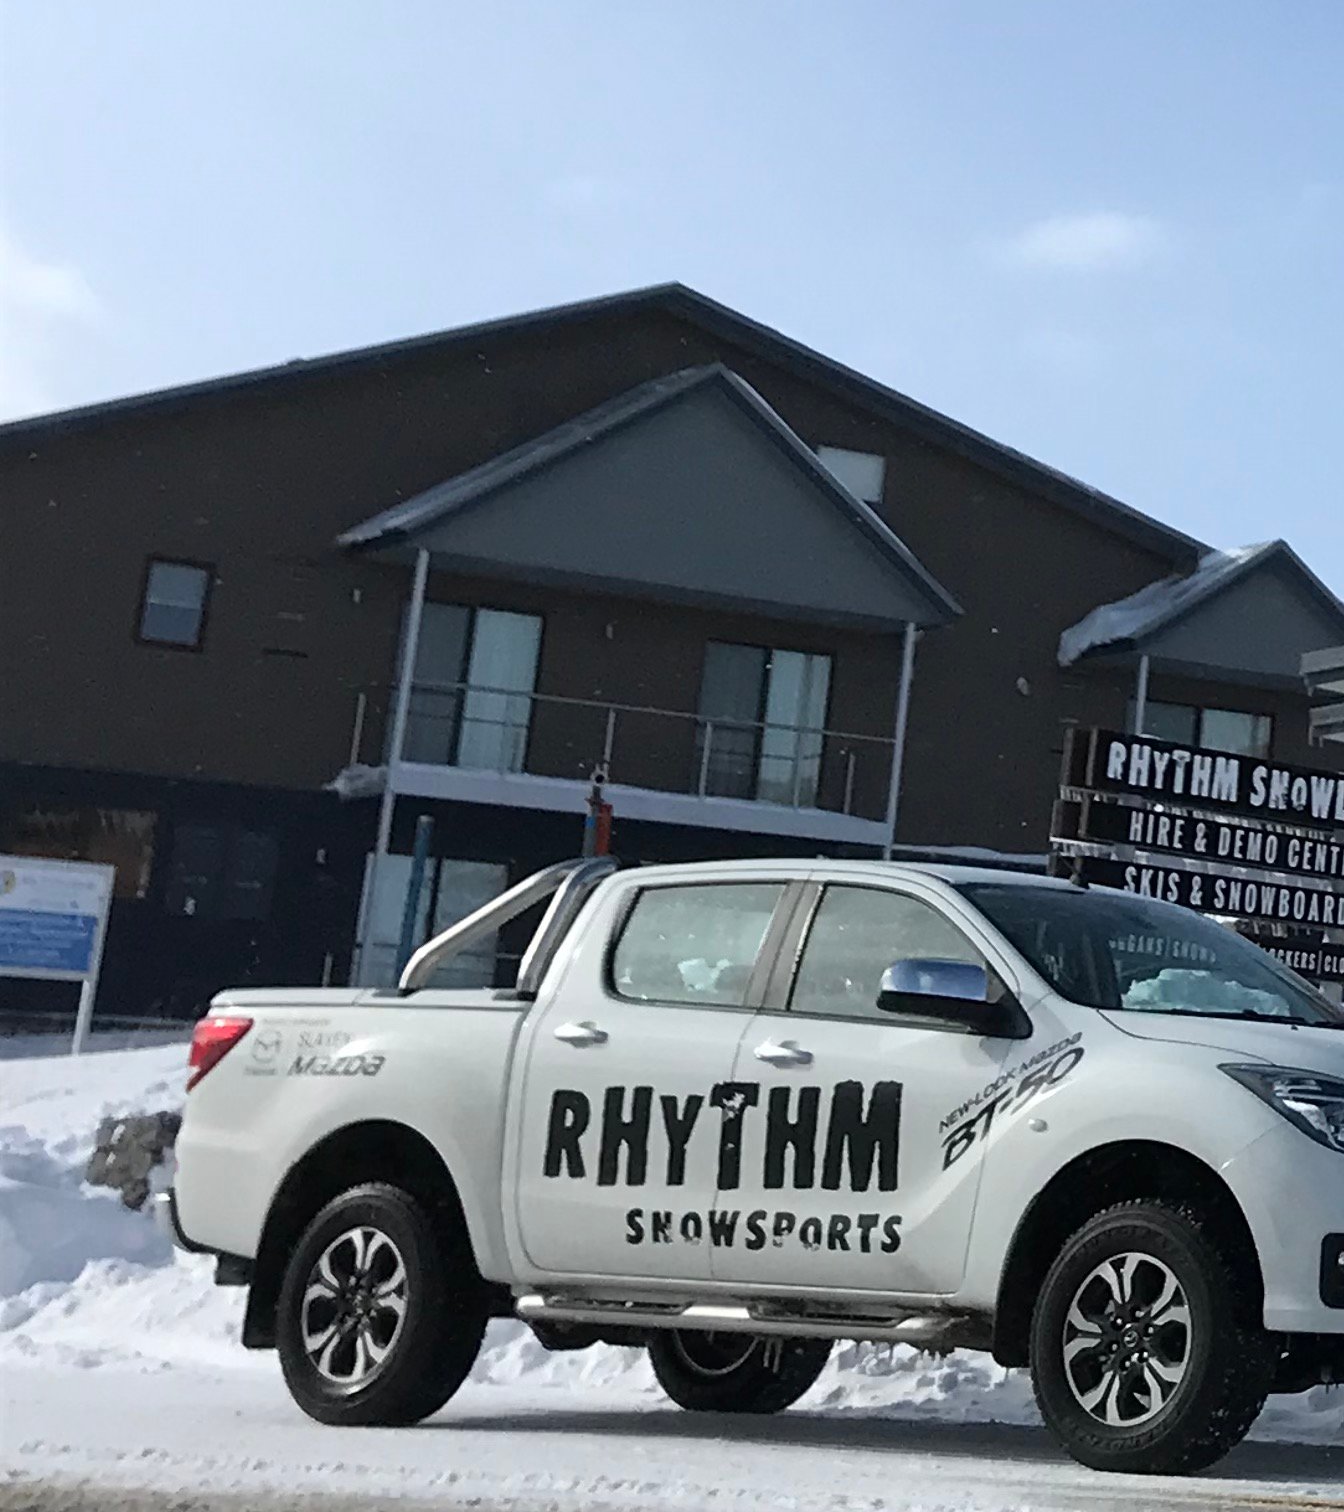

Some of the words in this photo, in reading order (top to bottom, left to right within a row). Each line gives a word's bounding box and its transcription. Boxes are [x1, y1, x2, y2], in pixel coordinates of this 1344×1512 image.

[1106, 740, 1241, 803] RHYTHM
[1128, 810, 1186, 849] HIRE
[1193, 822, 1207, 853] &
[1217, 826, 1278, 865] DEMO
[1124, 865, 1181, 903] SKIS
[1189, 875, 1203, 906] &
[543, 1078, 904, 1193] RHYTHM
[940, 1046, 1085, 1171] BT-50
[625, 1207, 903, 1254] SNOWSPORTS
